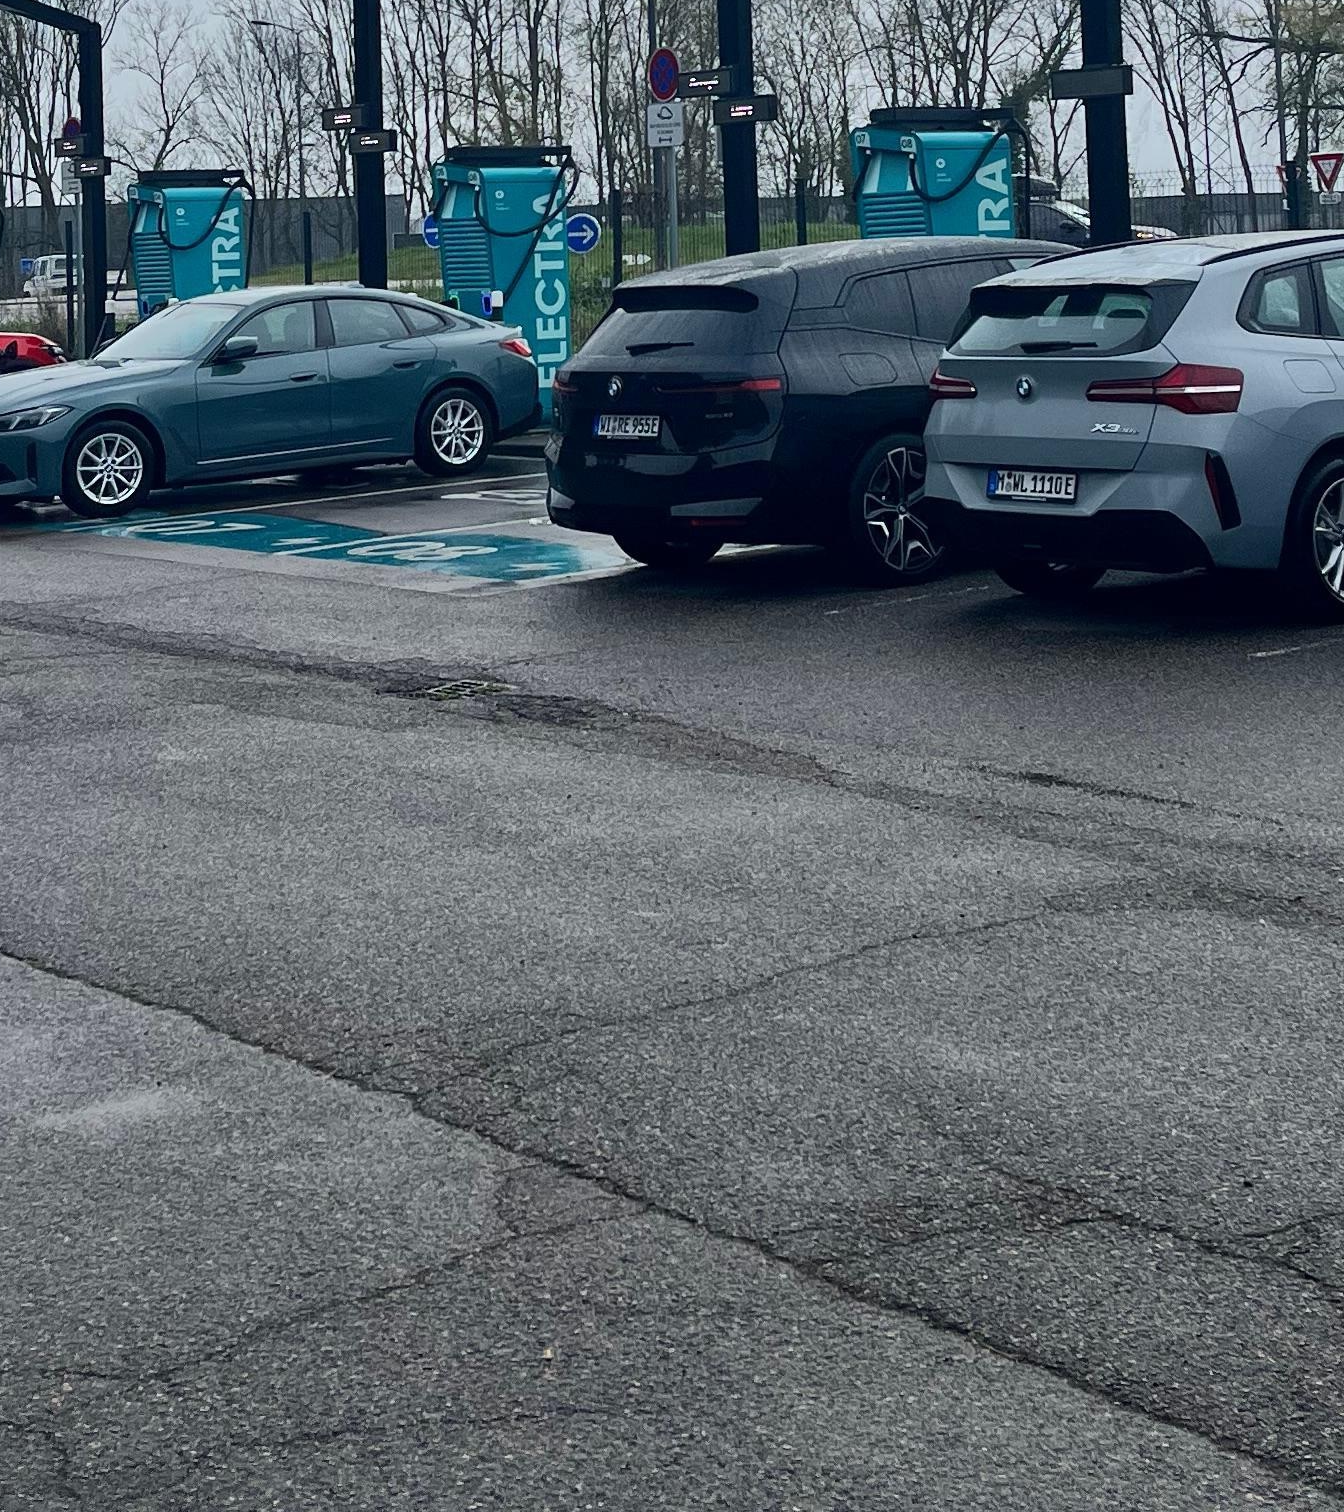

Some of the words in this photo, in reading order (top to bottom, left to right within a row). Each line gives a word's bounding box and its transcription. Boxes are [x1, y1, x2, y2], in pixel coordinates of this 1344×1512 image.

[975, 158, 1010, 238] RA
[211, 207, 240, 293] TRA
[618, 417, 630, 433] RE
[1090, 423, 1121, 433] X3
[1013, 474, 1027, 493] WL
[126, 520, 265, 535] 07
[346, 541, 499, 561] 08
